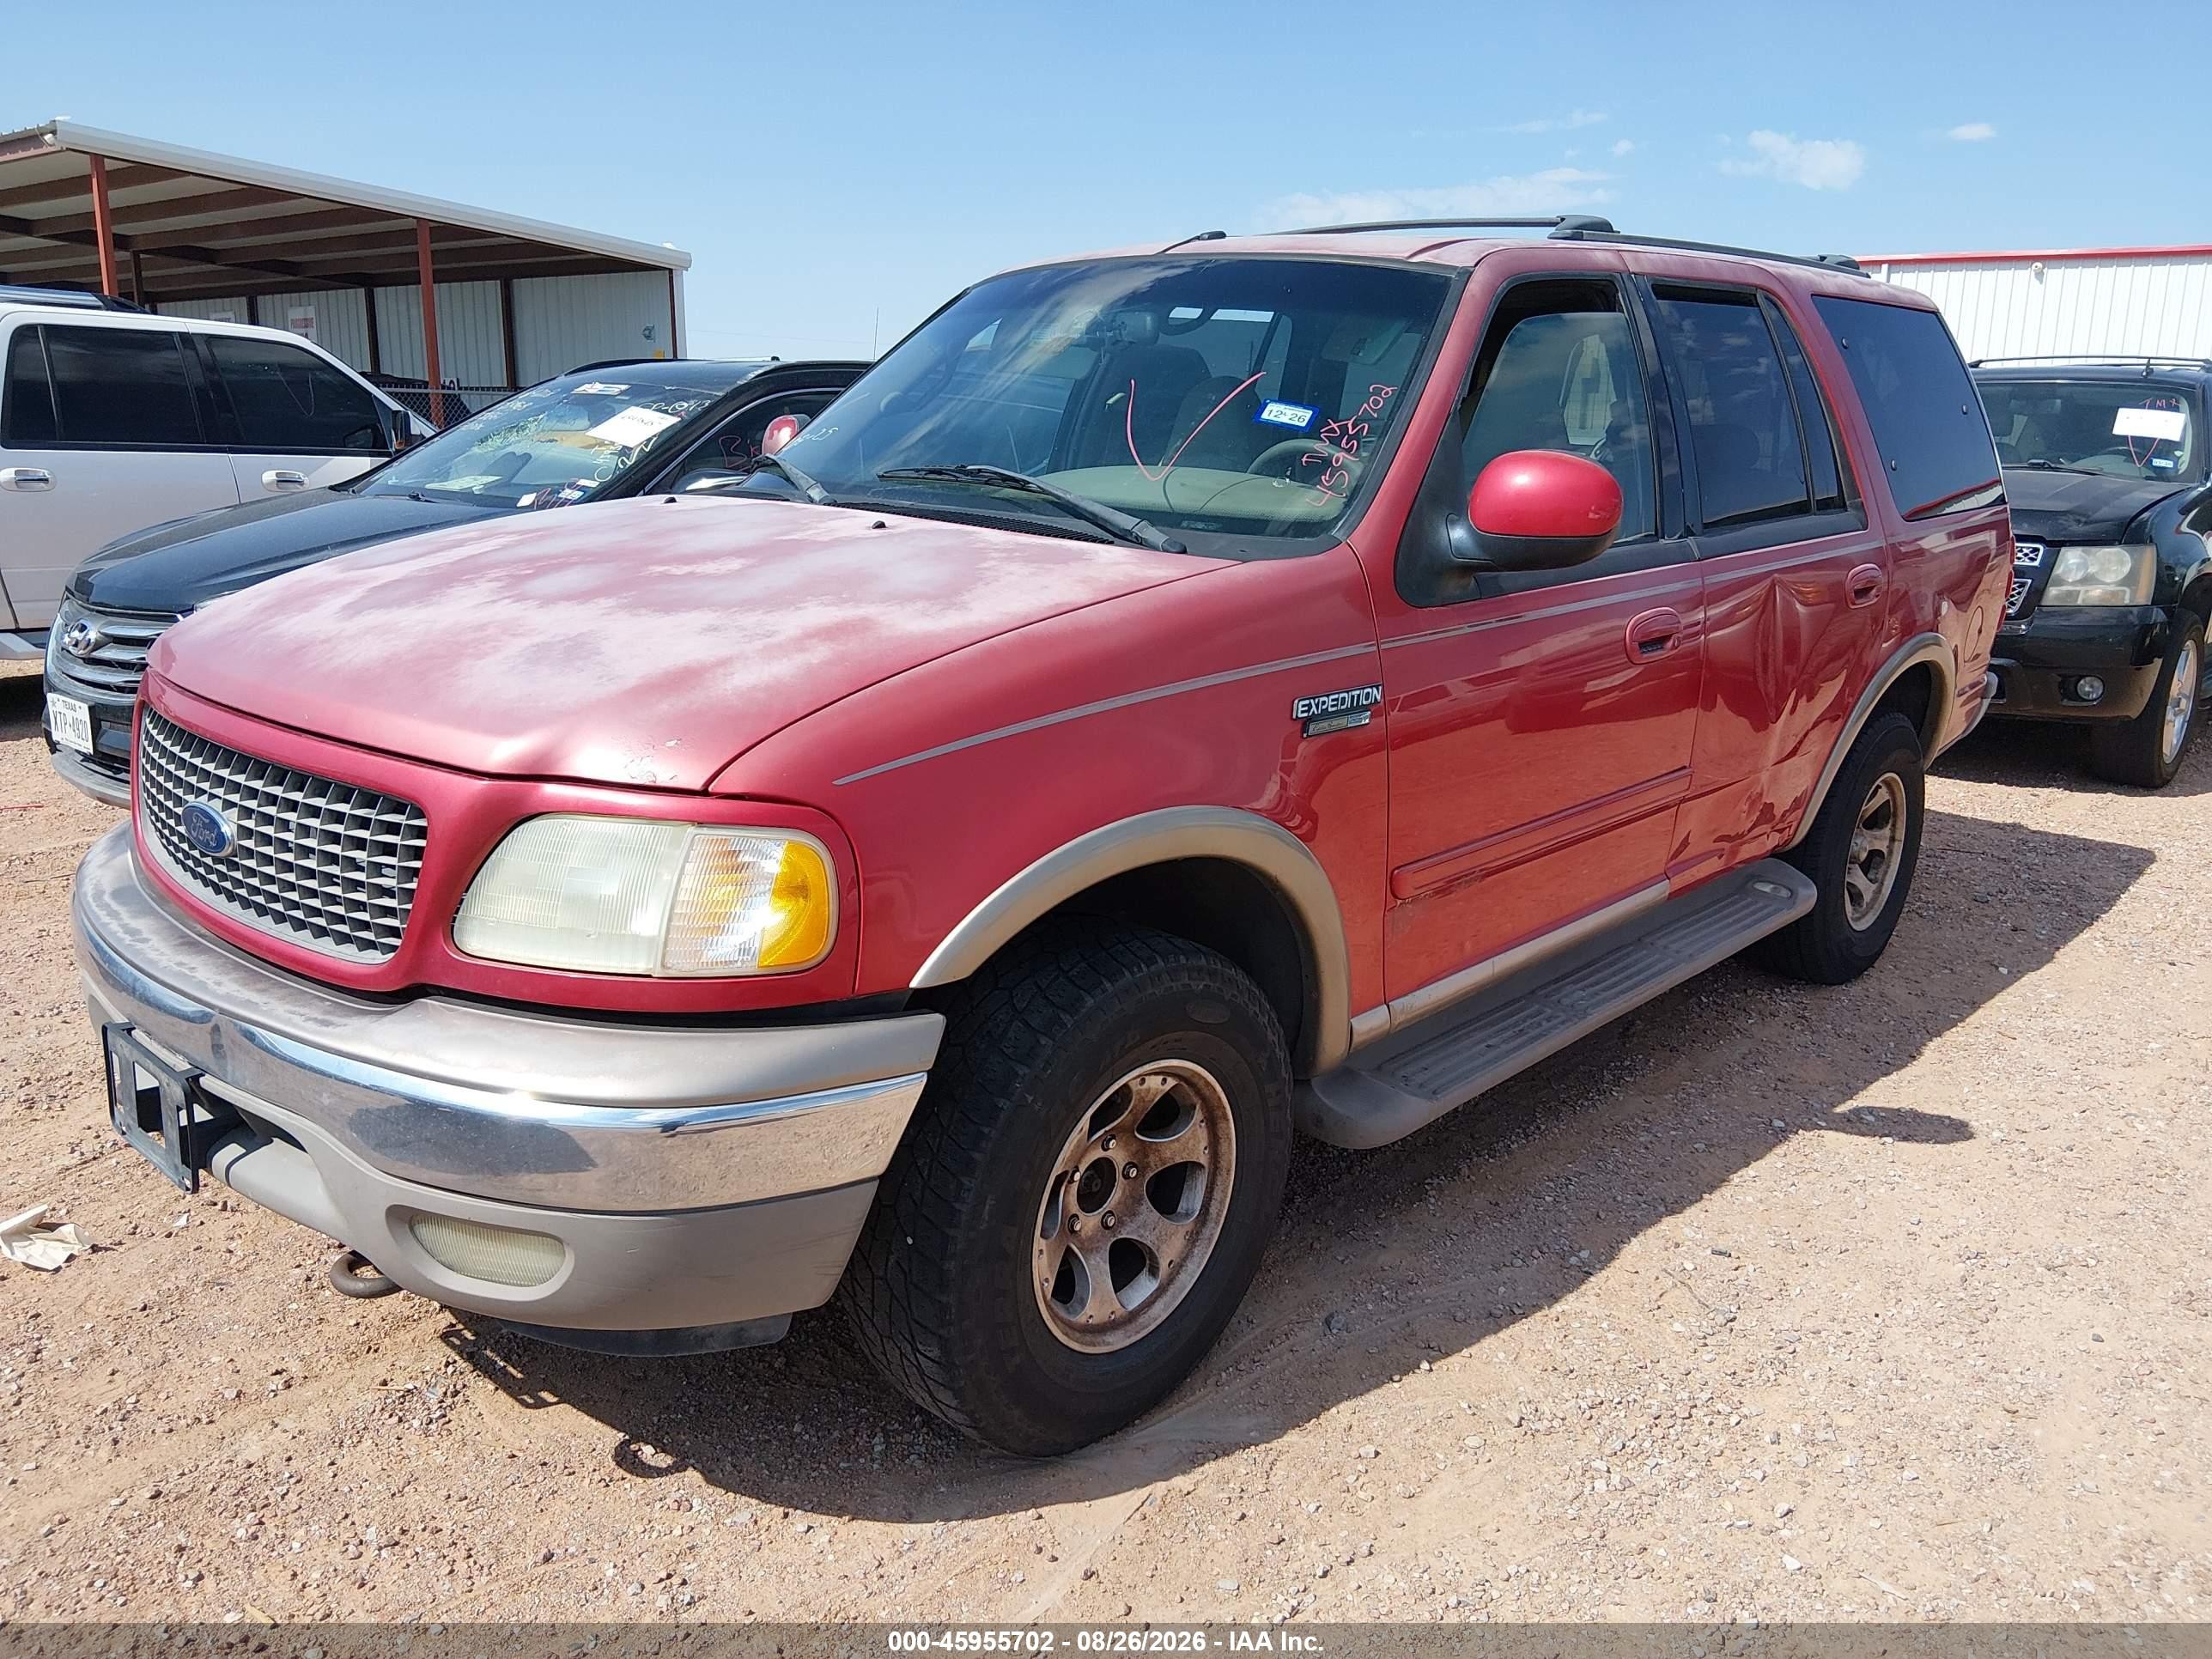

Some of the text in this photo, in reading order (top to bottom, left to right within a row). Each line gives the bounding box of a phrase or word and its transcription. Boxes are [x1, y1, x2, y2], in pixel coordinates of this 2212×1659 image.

[1267, 409, 1307, 423] 12 26
[1305, 384, 1398, 507] 45955702
[1297, 686, 1382, 718] EXPEDITION
[191, 811, 218, 848] Ford
